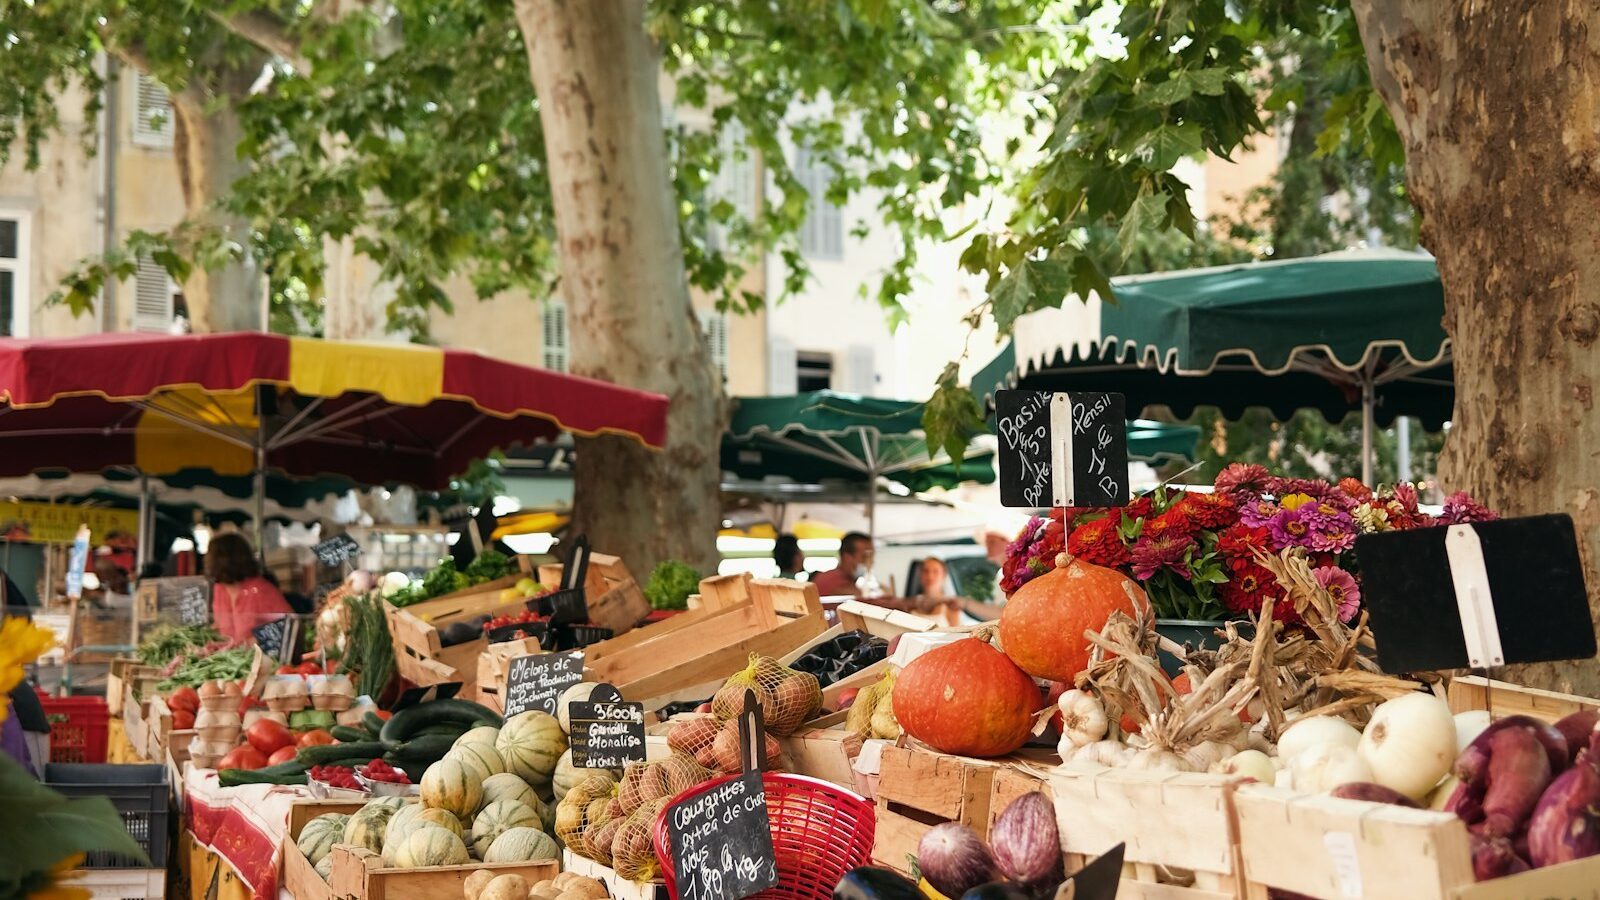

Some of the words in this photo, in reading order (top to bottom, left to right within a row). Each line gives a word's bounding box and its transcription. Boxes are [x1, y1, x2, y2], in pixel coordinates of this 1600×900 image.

[1098, 475, 1119, 499] B
[511, 657, 550, 683] Melons
[553, 658, 572, 671] de
[674, 780, 746, 831] Courgettes
[722, 804, 741, 824] de
